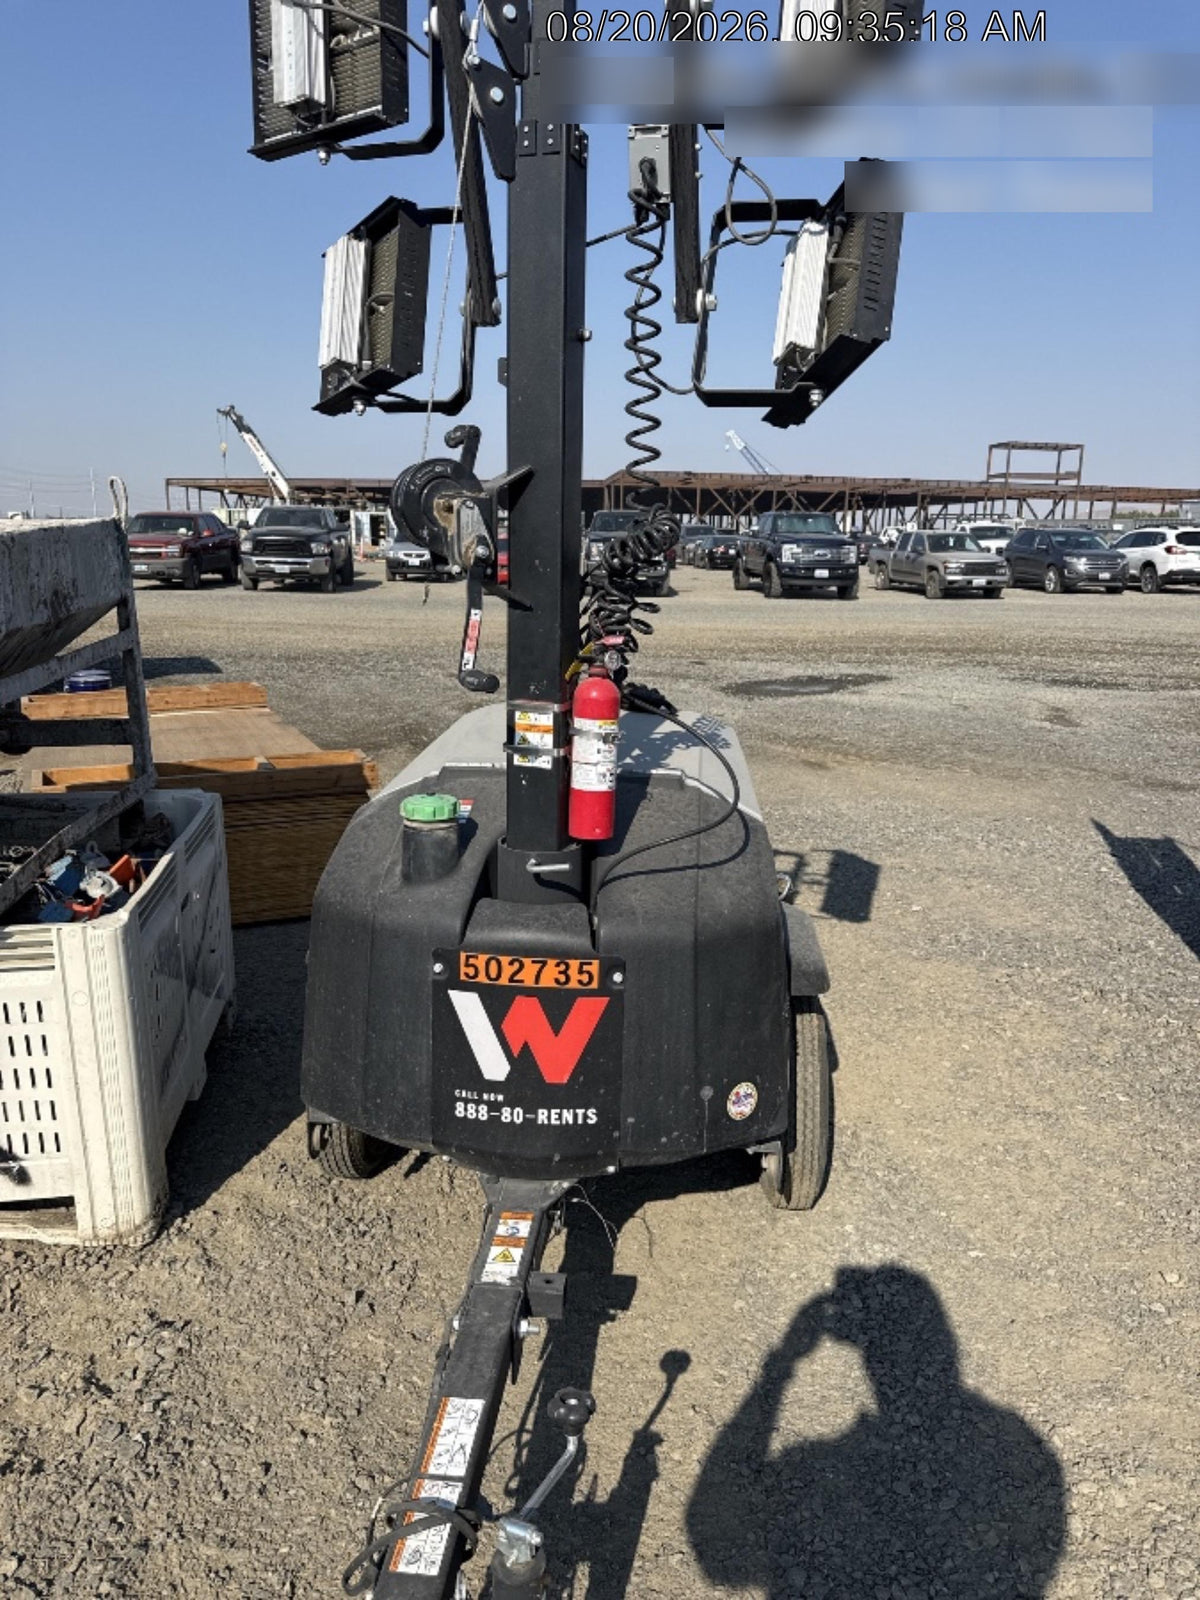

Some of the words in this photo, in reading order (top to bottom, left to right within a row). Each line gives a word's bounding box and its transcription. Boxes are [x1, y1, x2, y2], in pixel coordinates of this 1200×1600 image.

[463, 954, 595, 987] 502735
[483, 1092, 504, 1102] NOW
[454, 1101, 598, 1125] 888-80-RENTS
